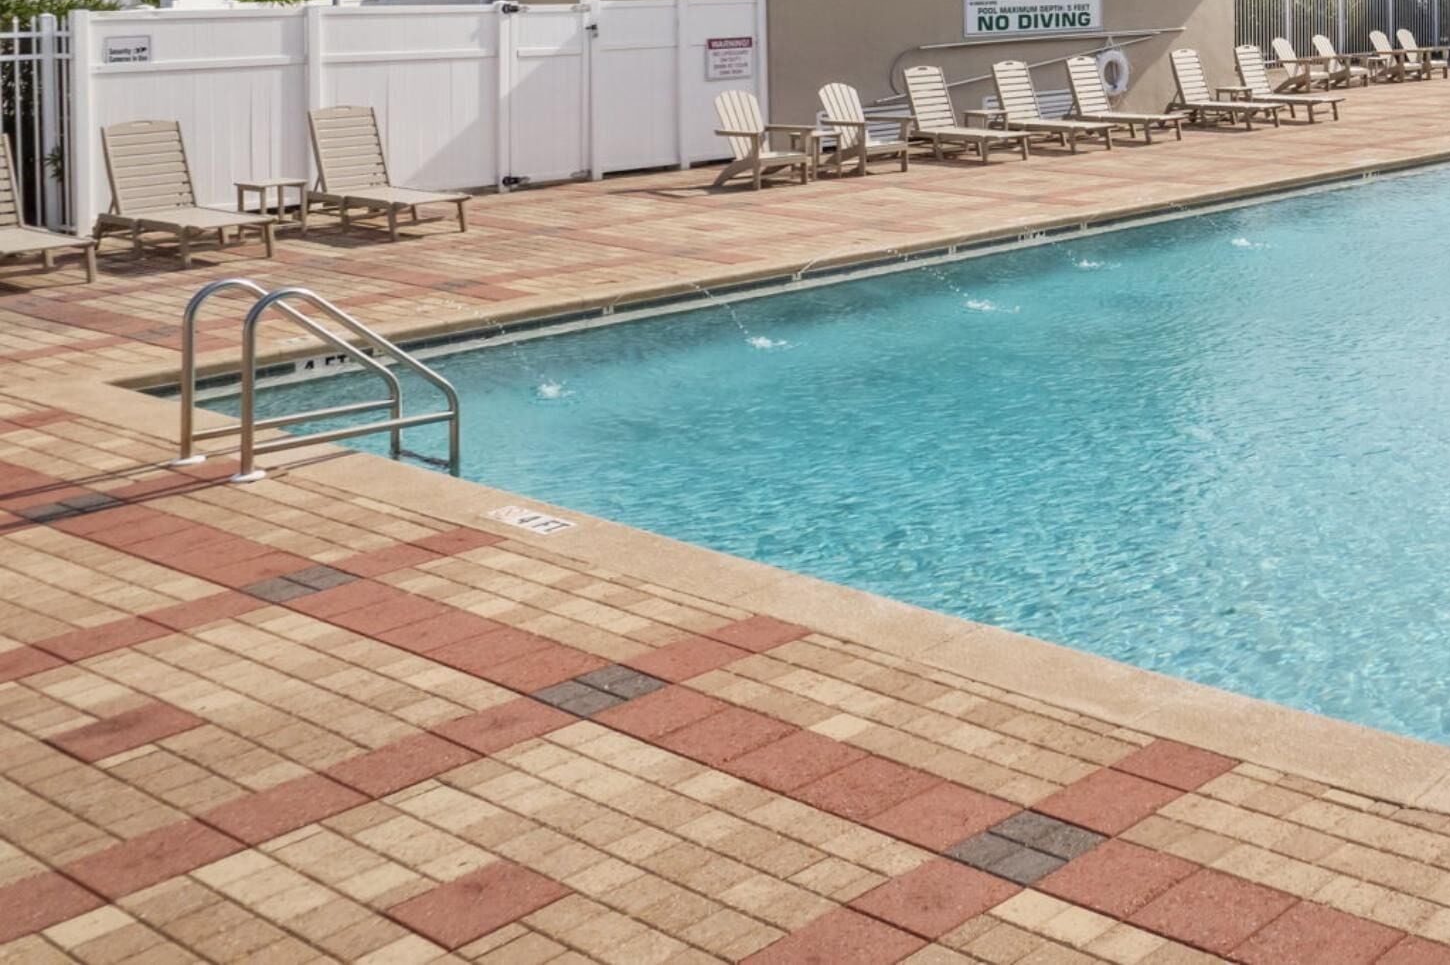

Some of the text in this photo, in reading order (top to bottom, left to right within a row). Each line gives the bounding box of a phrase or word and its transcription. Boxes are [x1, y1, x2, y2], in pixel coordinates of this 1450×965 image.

[977, 7, 998, 15] POOL
[999, 6, 1038, 14] MAXIMUM
[1039, 5, 1065, 13] DEPTH:
[1073, 3, 1090, 11] FEET
[977, 12, 1091, 31] NO DIVING
[710, 39, 750, 48] WARNING!
